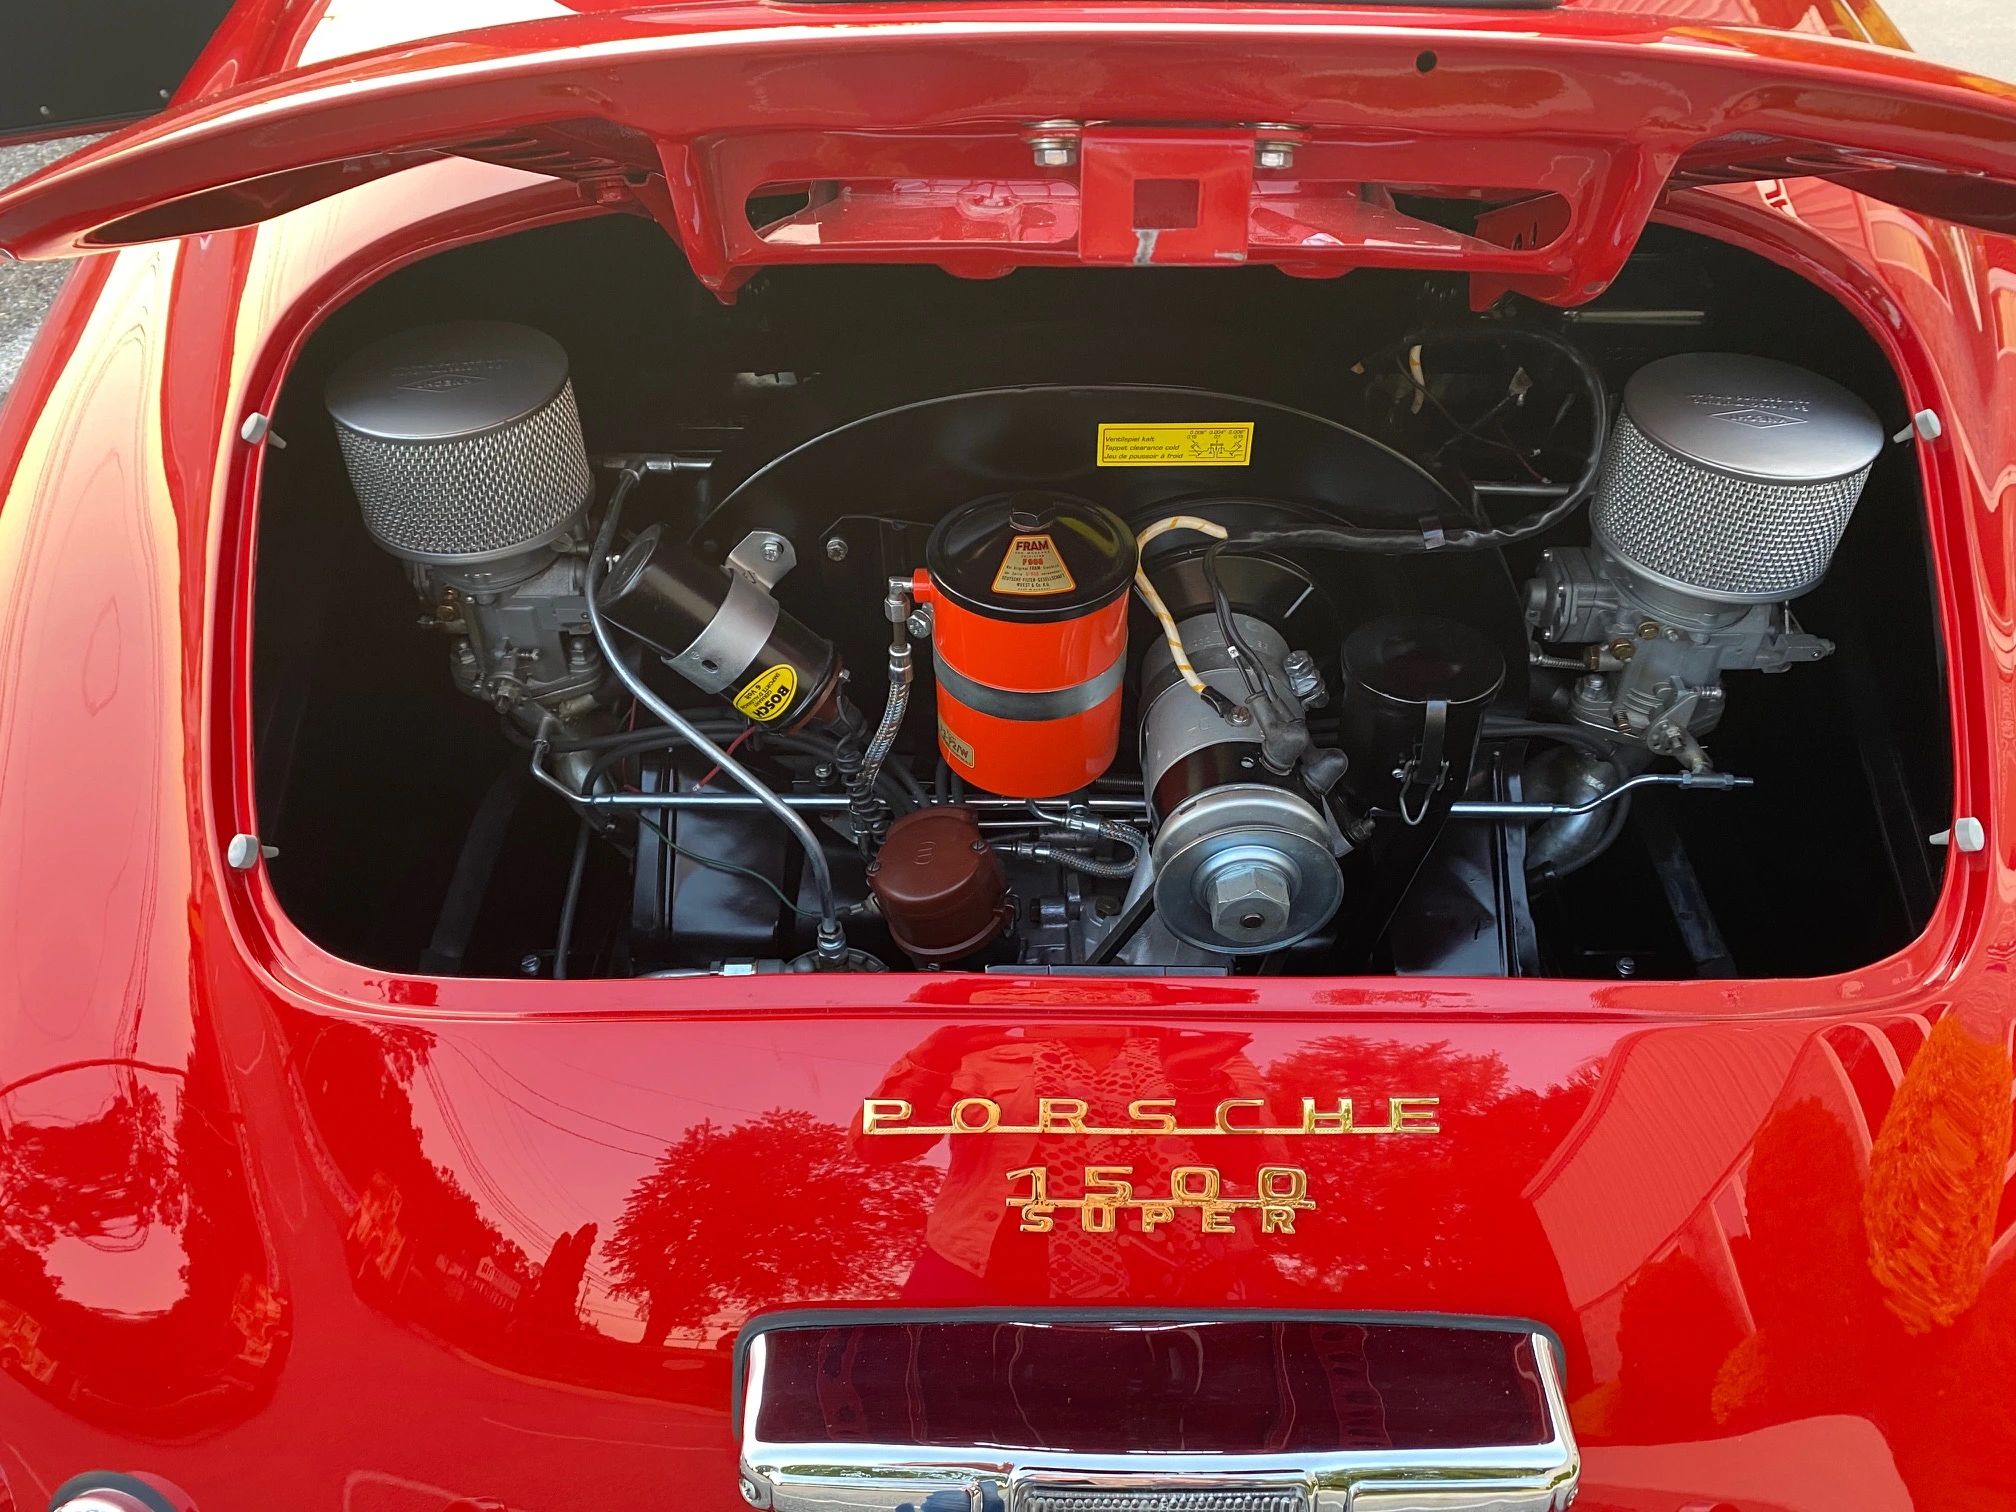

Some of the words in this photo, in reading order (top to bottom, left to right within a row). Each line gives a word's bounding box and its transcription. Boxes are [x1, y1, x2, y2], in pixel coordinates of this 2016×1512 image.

[1016, 541, 1049, 551] FRAM
[743, 689, 757, 700] Volt
[752, 684, 791, 718] BOSCH
[863, 1097, 1440, 1134] PORSCHE
[1006, 1165, 1308, 1202] 1500
[1019, 1205, 1297, 1234] SUPER
